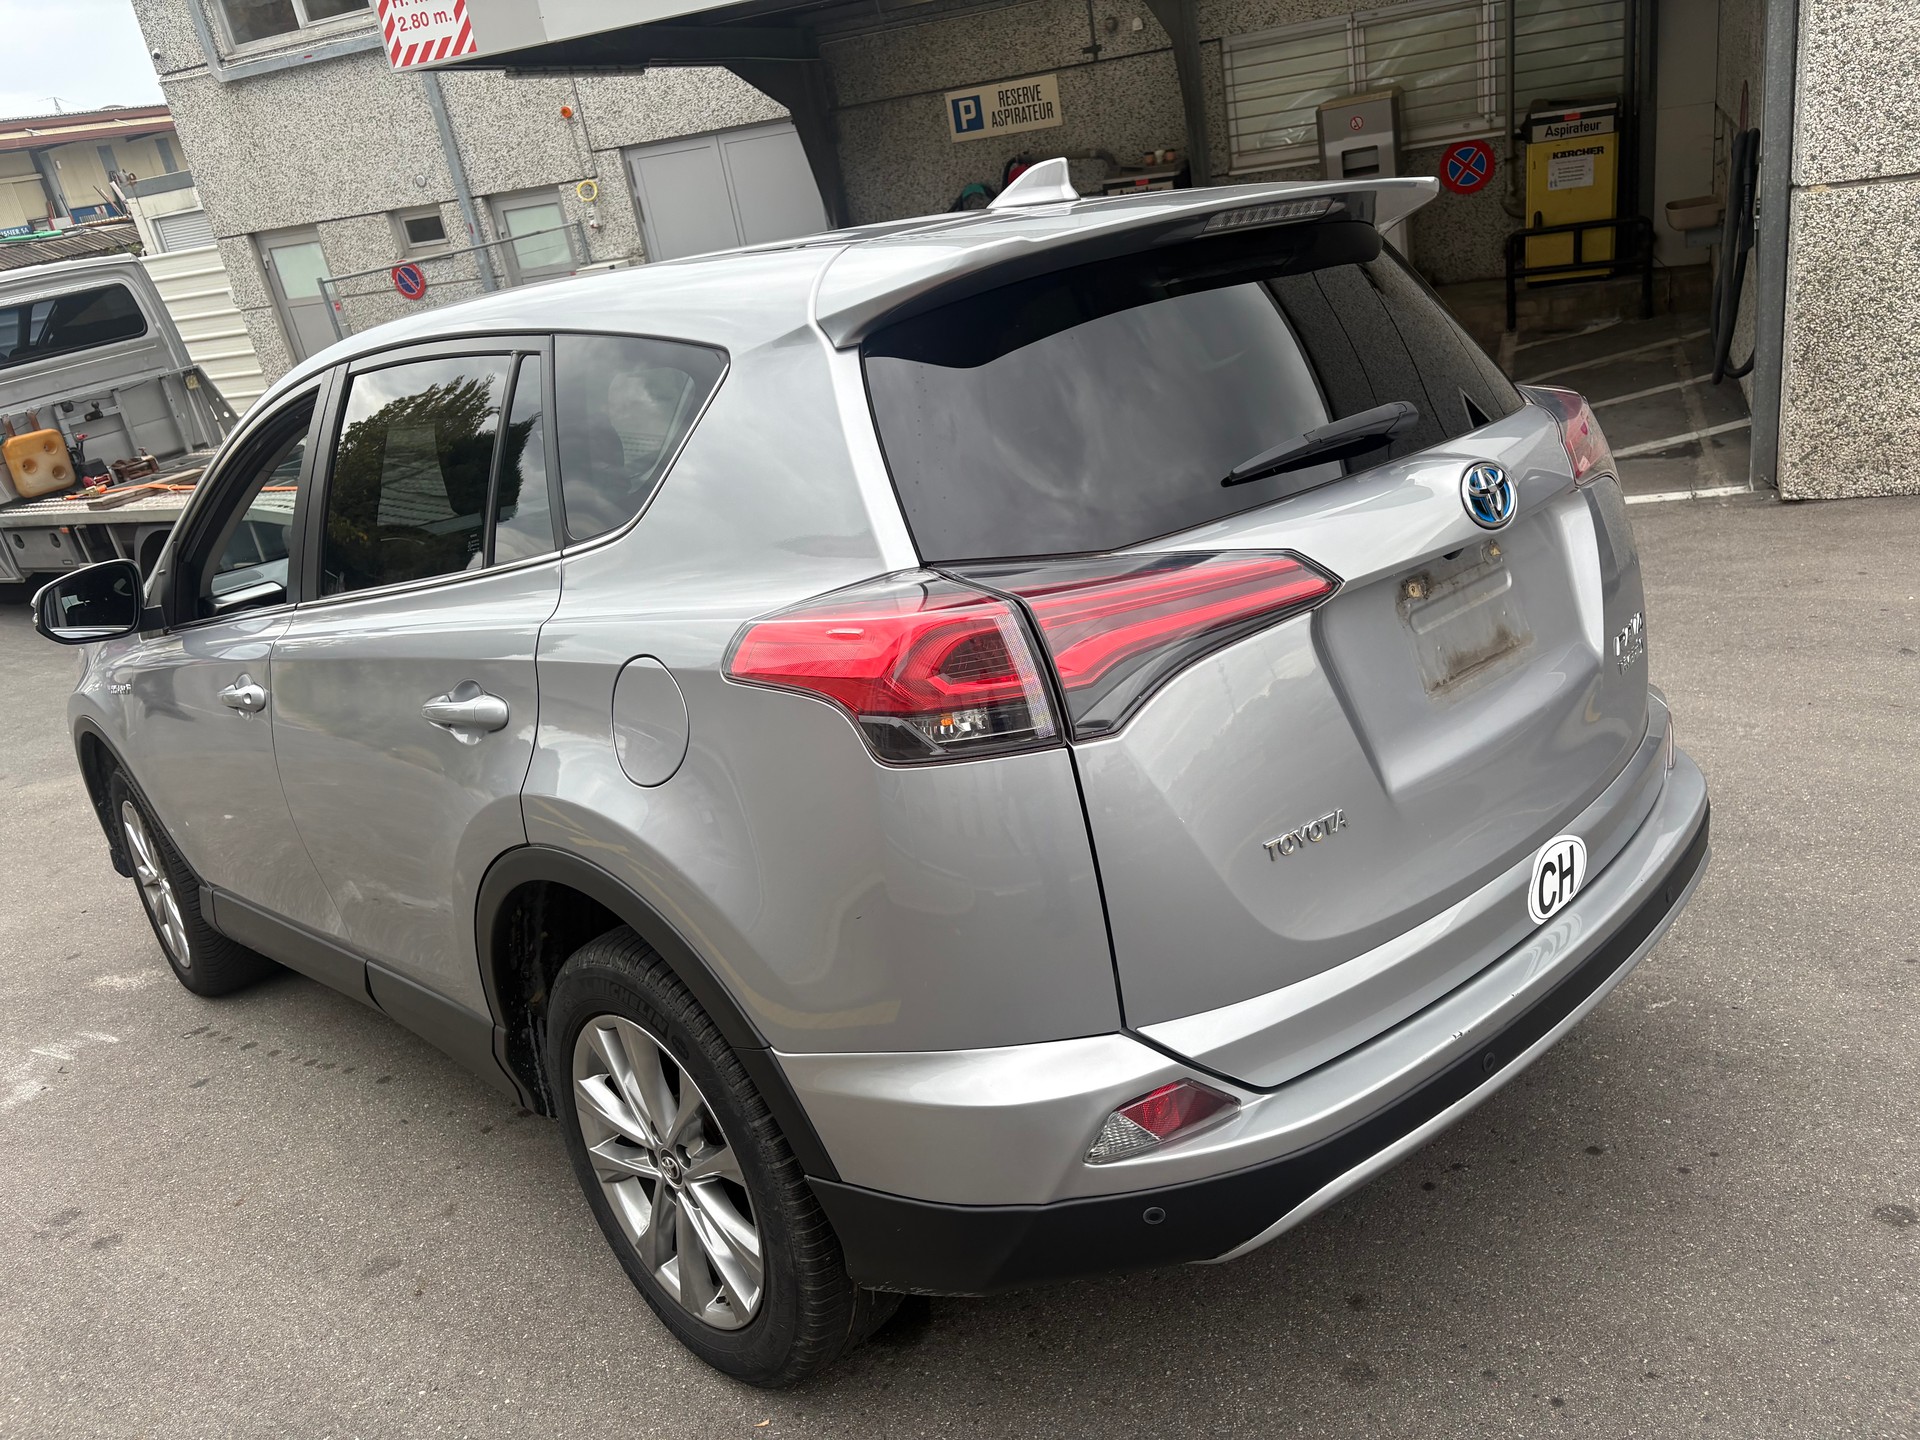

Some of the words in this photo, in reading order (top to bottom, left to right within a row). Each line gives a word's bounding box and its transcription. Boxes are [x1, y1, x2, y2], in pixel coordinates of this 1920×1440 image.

[397, 11, 429, 32] 2.80
[433, 10, 452, 25] m.
[998, 84, 1042, 107] RESERVE
[958, 99, 977, 130] P
[991, 102, 1054, 128] ASPIRATEUR
[1544, 120, 1602, 138] Aspirateur
[1263, 808, 1348, 861] TOYOTA
[1539, 844, 1575, 915] CH
